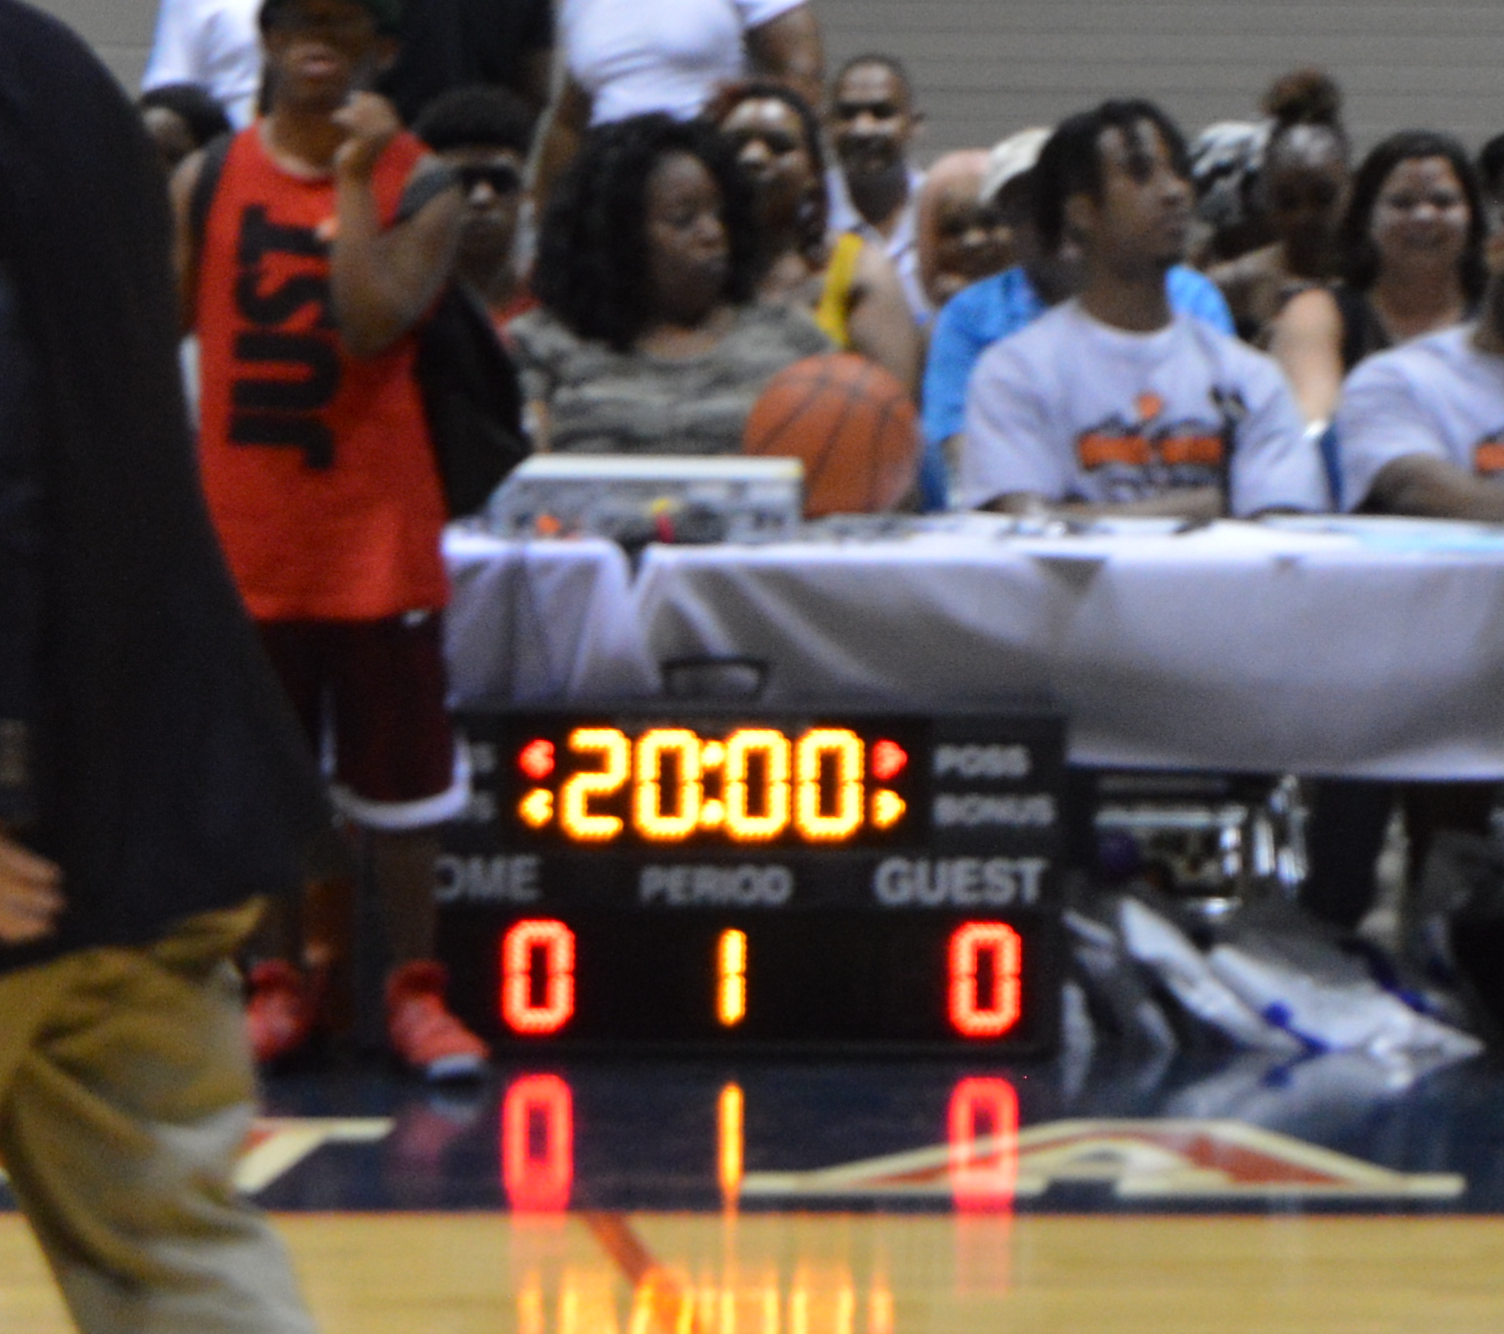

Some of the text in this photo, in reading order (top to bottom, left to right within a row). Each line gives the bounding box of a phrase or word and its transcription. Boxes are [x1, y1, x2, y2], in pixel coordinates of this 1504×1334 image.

[560, 725, 866, 843] 20:00
[934, 792, 1056, 828] BONUS
[435, 855, 543, 904] OME
[640, 865, 793, 906] PERIOD
[874, 857, 1050, 907] GUEST
[501, 919, 576, 1034] 0
[715, 927, 748, 1026] 1
[948, 920, 1022, 1036] 0
